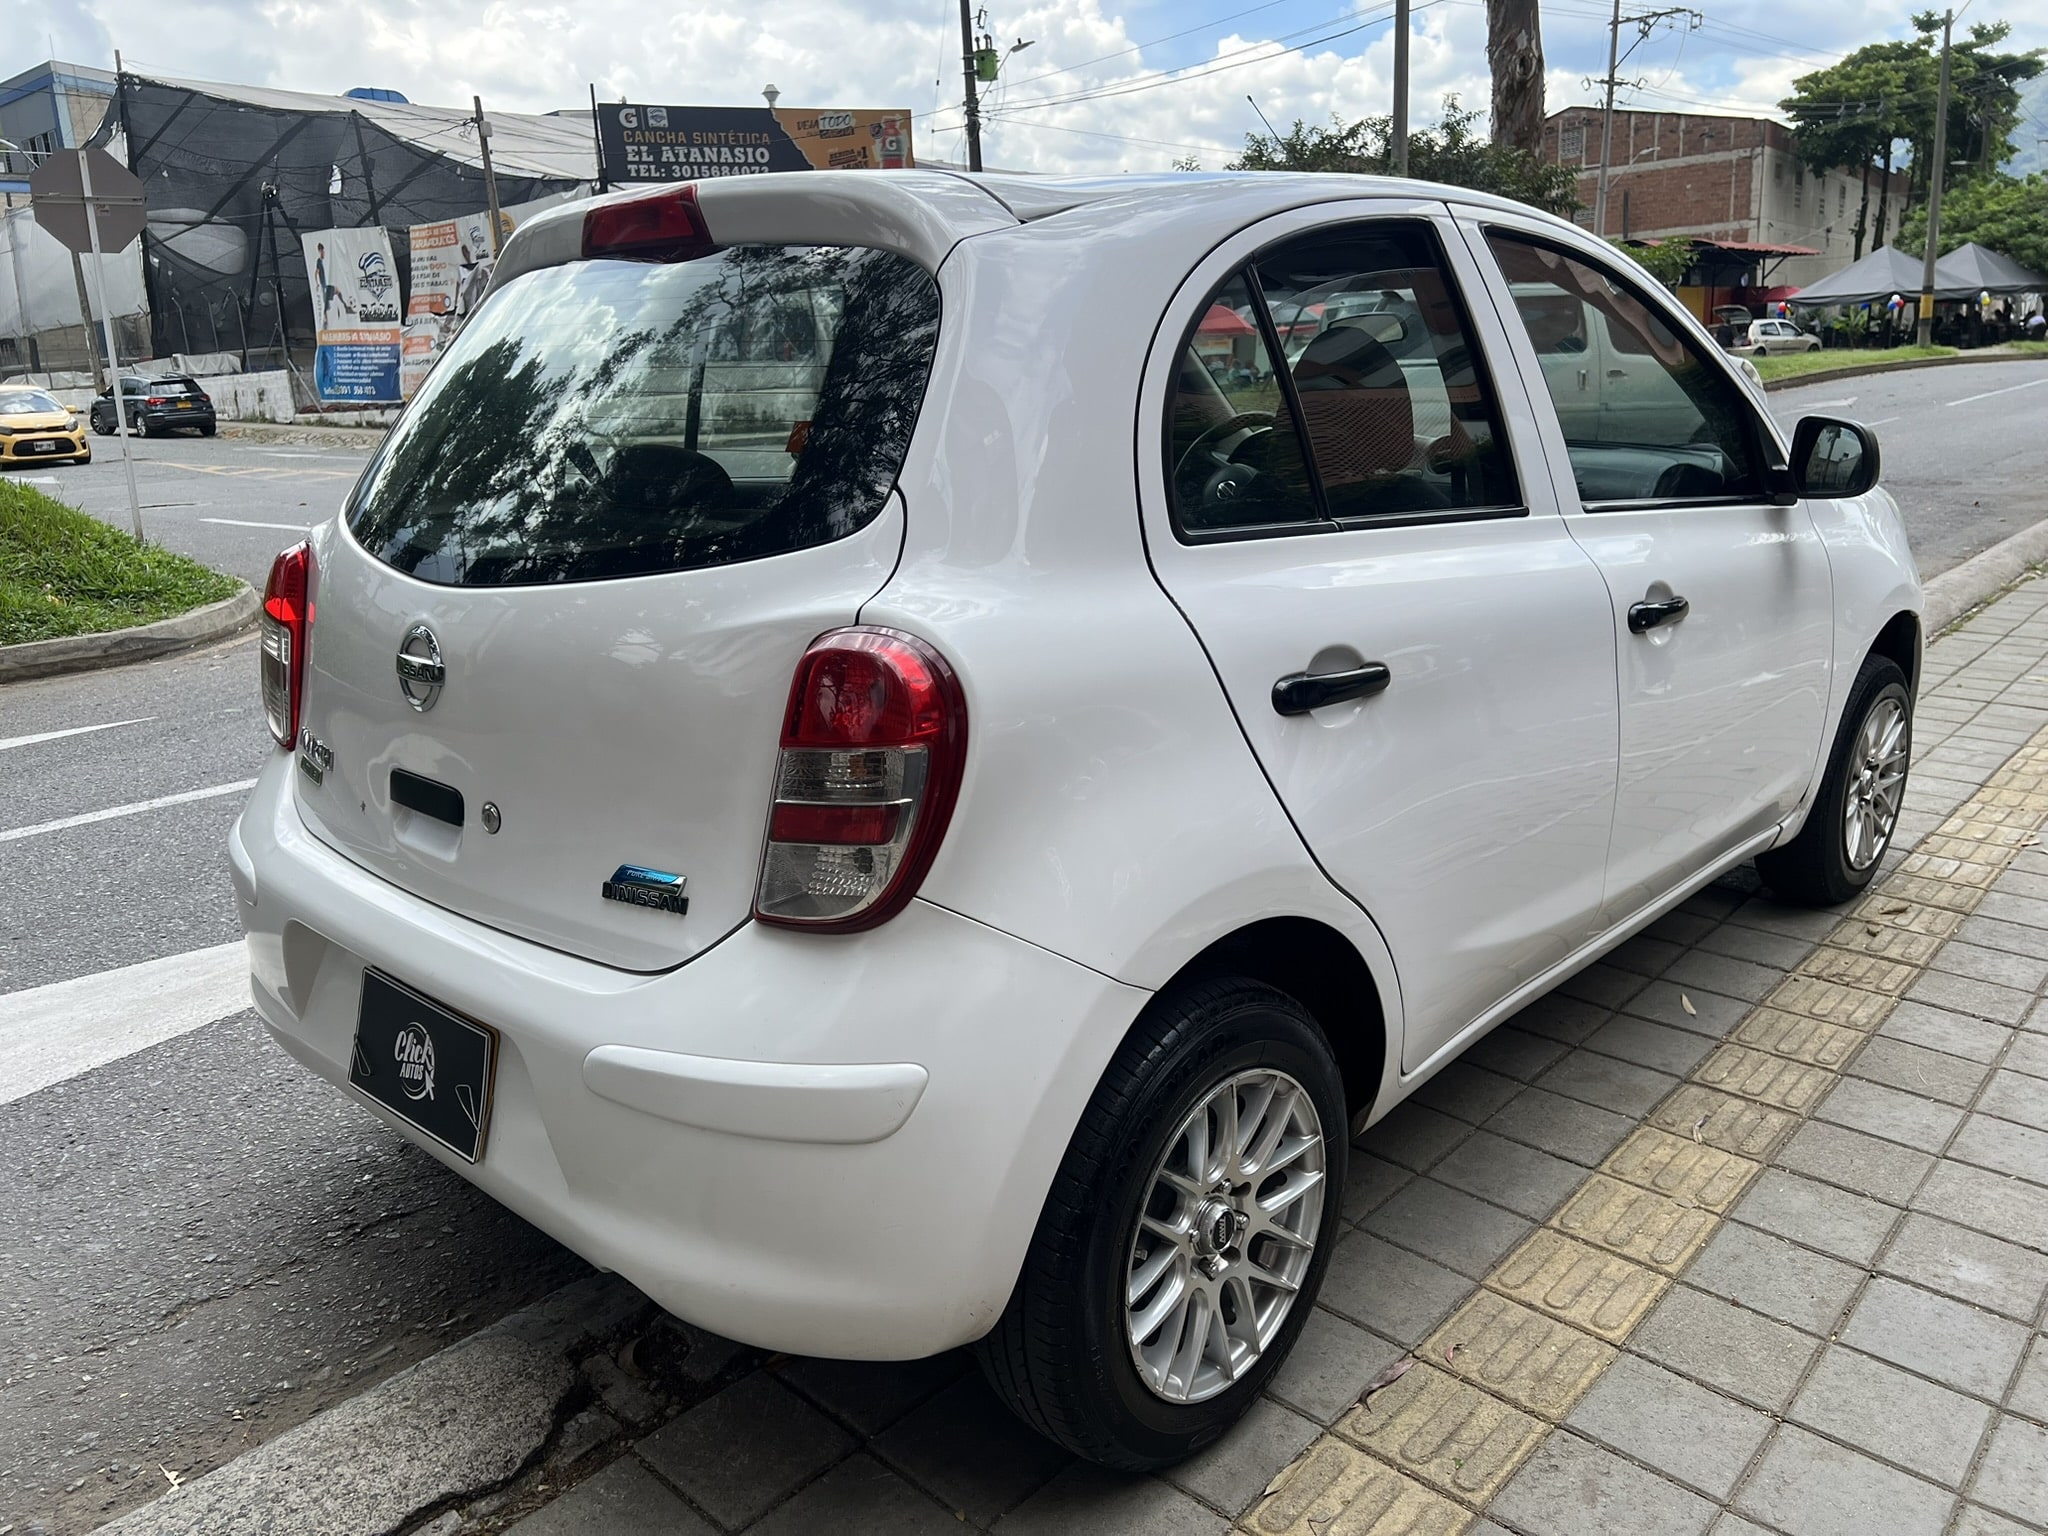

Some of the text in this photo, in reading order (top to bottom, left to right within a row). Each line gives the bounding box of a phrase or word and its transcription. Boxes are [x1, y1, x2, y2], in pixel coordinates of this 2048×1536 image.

[820, 114, 850, 129] TODO
[623, 130, 772, 145] CANCHA SINTÉTICA
[625, 145, 770, 164] EL ATANASIO
[627, 164, 667, 178] TEL:
[399, 656, 434, 682] SSAN
[612, 881, 687, 915] NISSAN
[394, 1030, 434, 1072] Click
[399, 1062, 424, 1080] AUTOS
